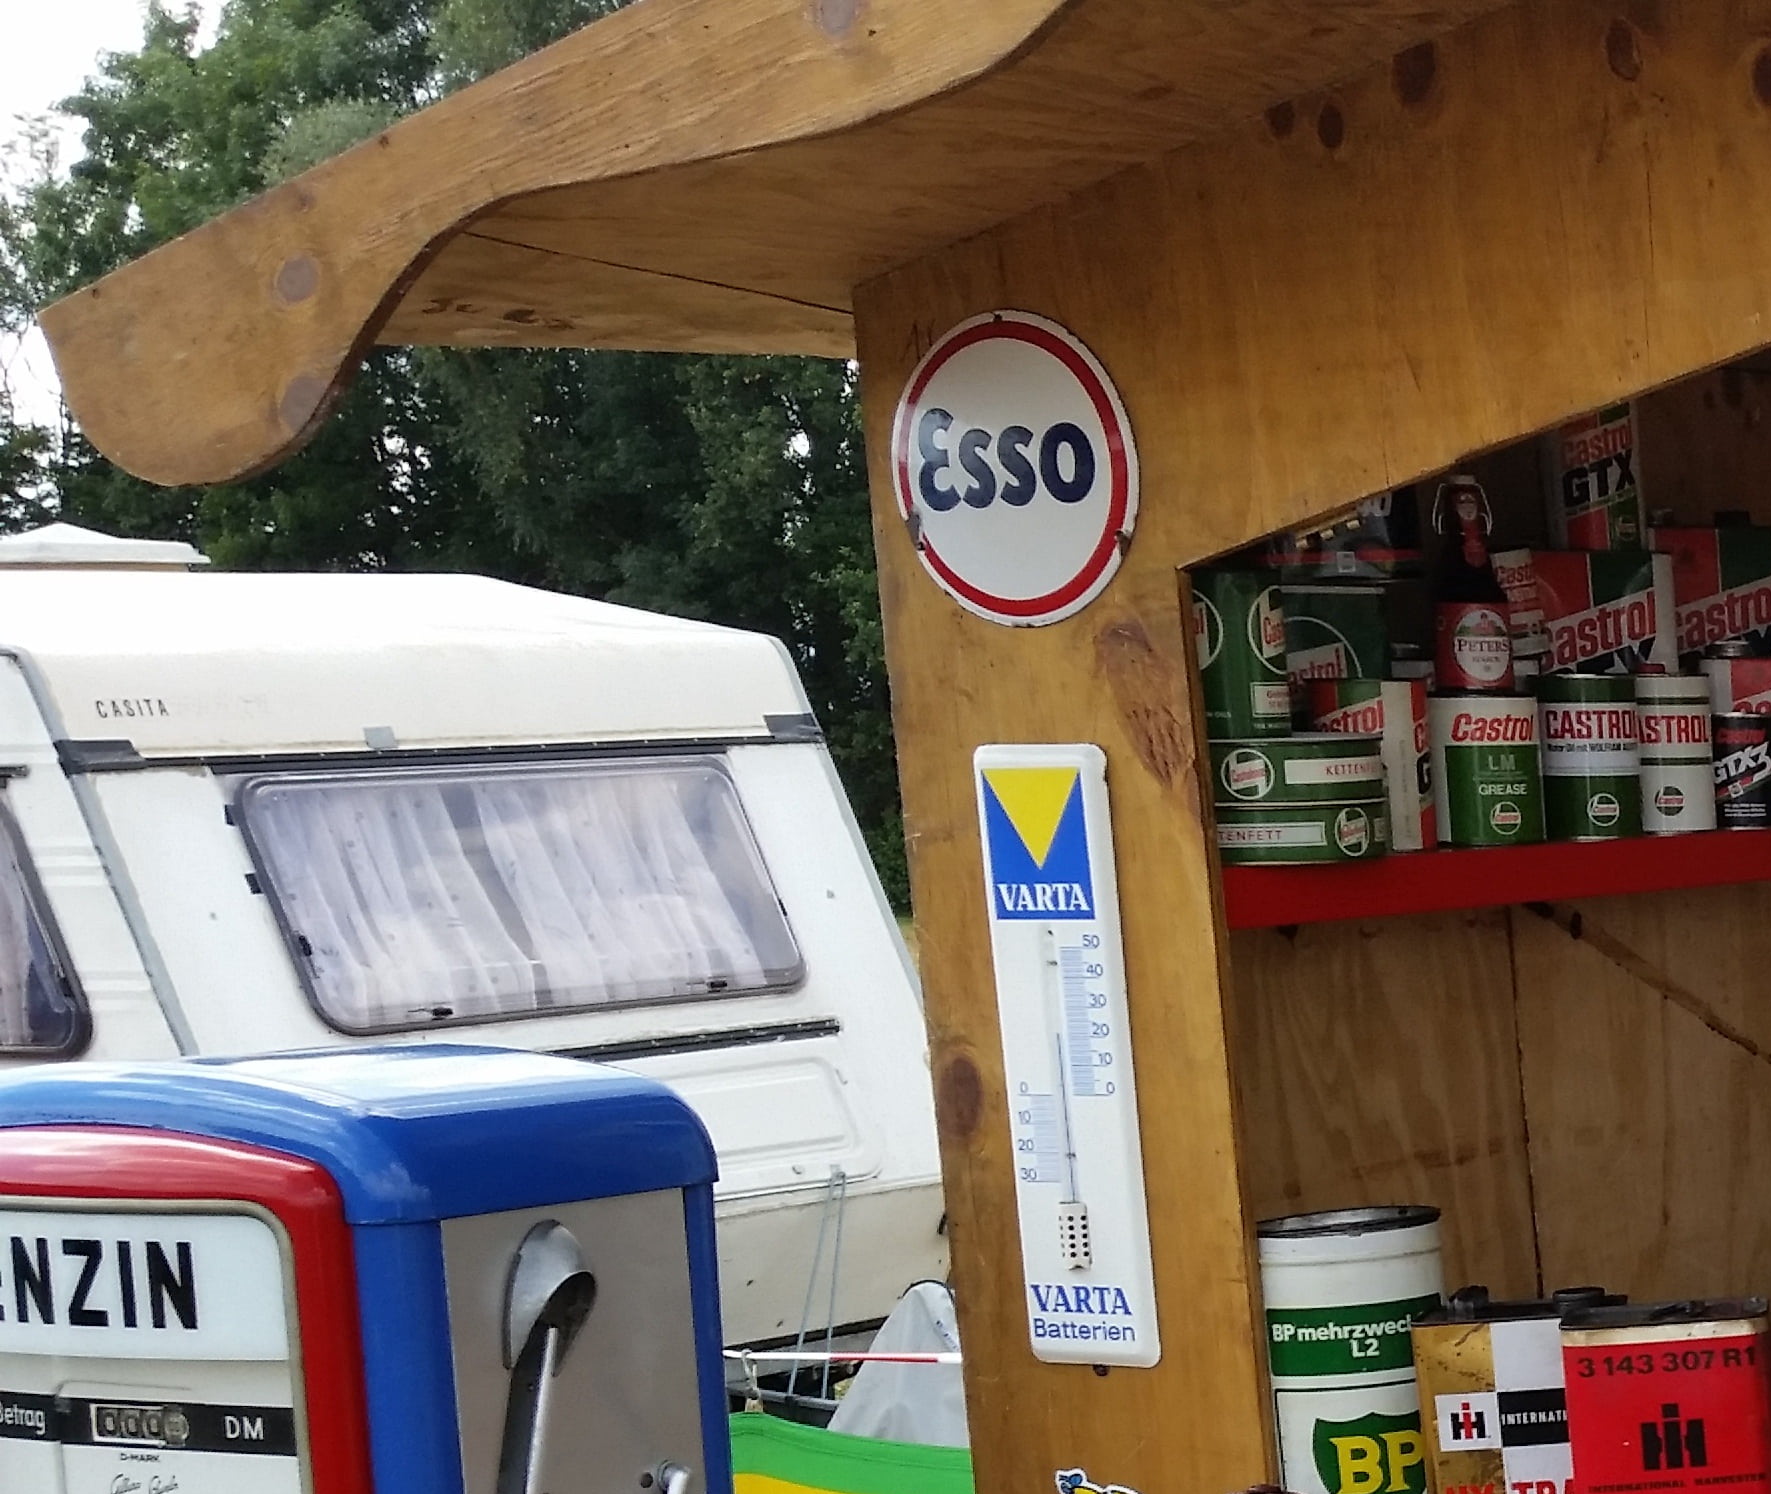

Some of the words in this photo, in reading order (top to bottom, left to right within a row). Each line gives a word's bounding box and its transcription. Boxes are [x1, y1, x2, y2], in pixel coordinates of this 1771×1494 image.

[1562, 451, 1635, 507] GTX
[96, 699, 169, 719] CASITA
[1451, 713, 1534, 742] Castrol
[1478, 783, 1527, 795] GREASE
[997, 883, 1091, 913] VARTA
[1083, 935, 1100, 948] 50
[1086, 963, 1104, 977] 40
[1089, 993, 1107, 1007] 30
[1092, 1023, 1110, 1037] 20
[1097, 1052, 1113, 1066] 10
[1019, 1081, 1029, 1094] 0
[1106, 1082, 1116, 1095] 0
[1018, 1110, 1032, 1123] 10
[1018, 1138, 1034, 1152] 20
[0, 1237, 200, 1331] NZIN
[1030, 1283, 1133, 1316] VARTA
[1032, 1318, 1136, 1343] Batterien
[1350, 1337, 1380, 1358] L2
[1578, 1357, 1596, 1378] 3
[1604, 1354, 1654, 1376] 143
[1666, 1350, 1716, 1373] 307
[1723, 1348, 1756, 1369] R1
[224, 1416, 266, 1440] DM
[1588, 1480, 1686, 1494] INTERNATIONAL
